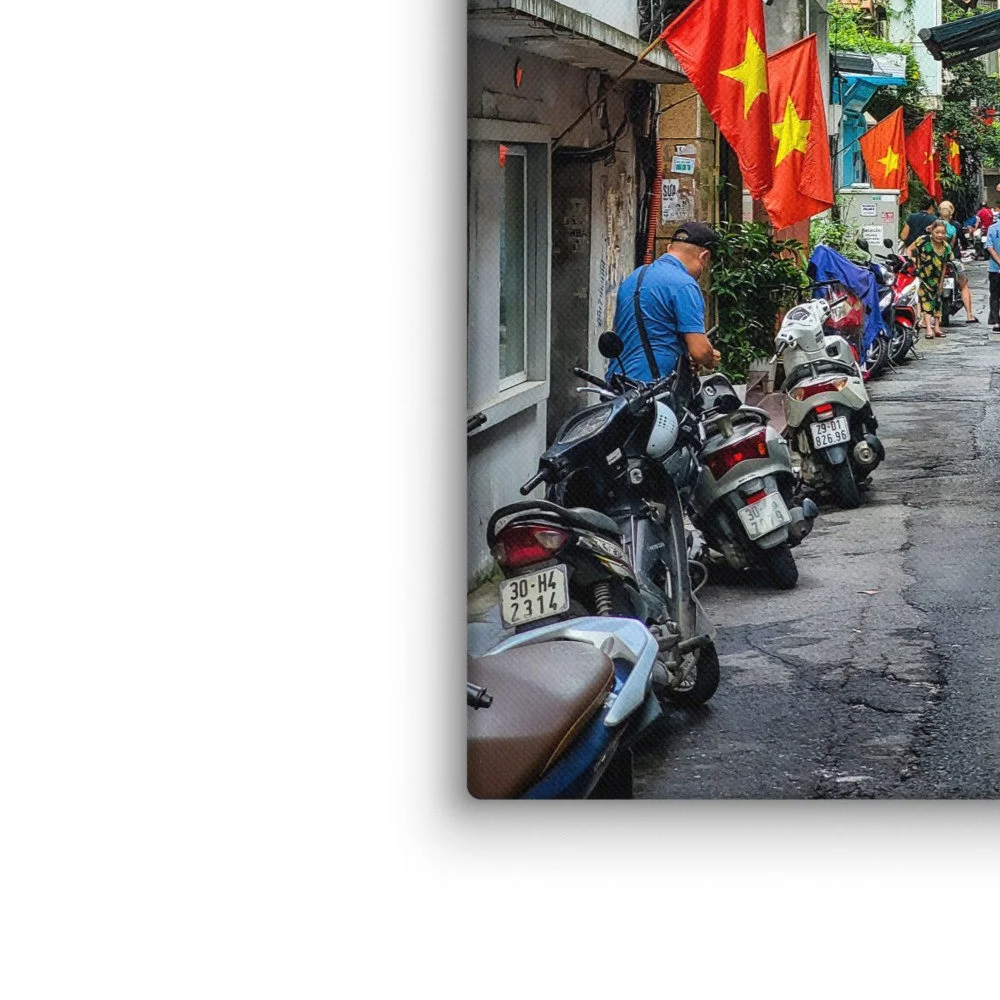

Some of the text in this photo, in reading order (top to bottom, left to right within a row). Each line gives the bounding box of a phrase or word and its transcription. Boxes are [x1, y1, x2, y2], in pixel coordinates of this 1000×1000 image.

[815, 429, 847, 447] 826.96
[816, 420, 841, 435] 29-D1
[509, 570, 557, 600] 30-H4
[510, 591, 558, 622] 2314
